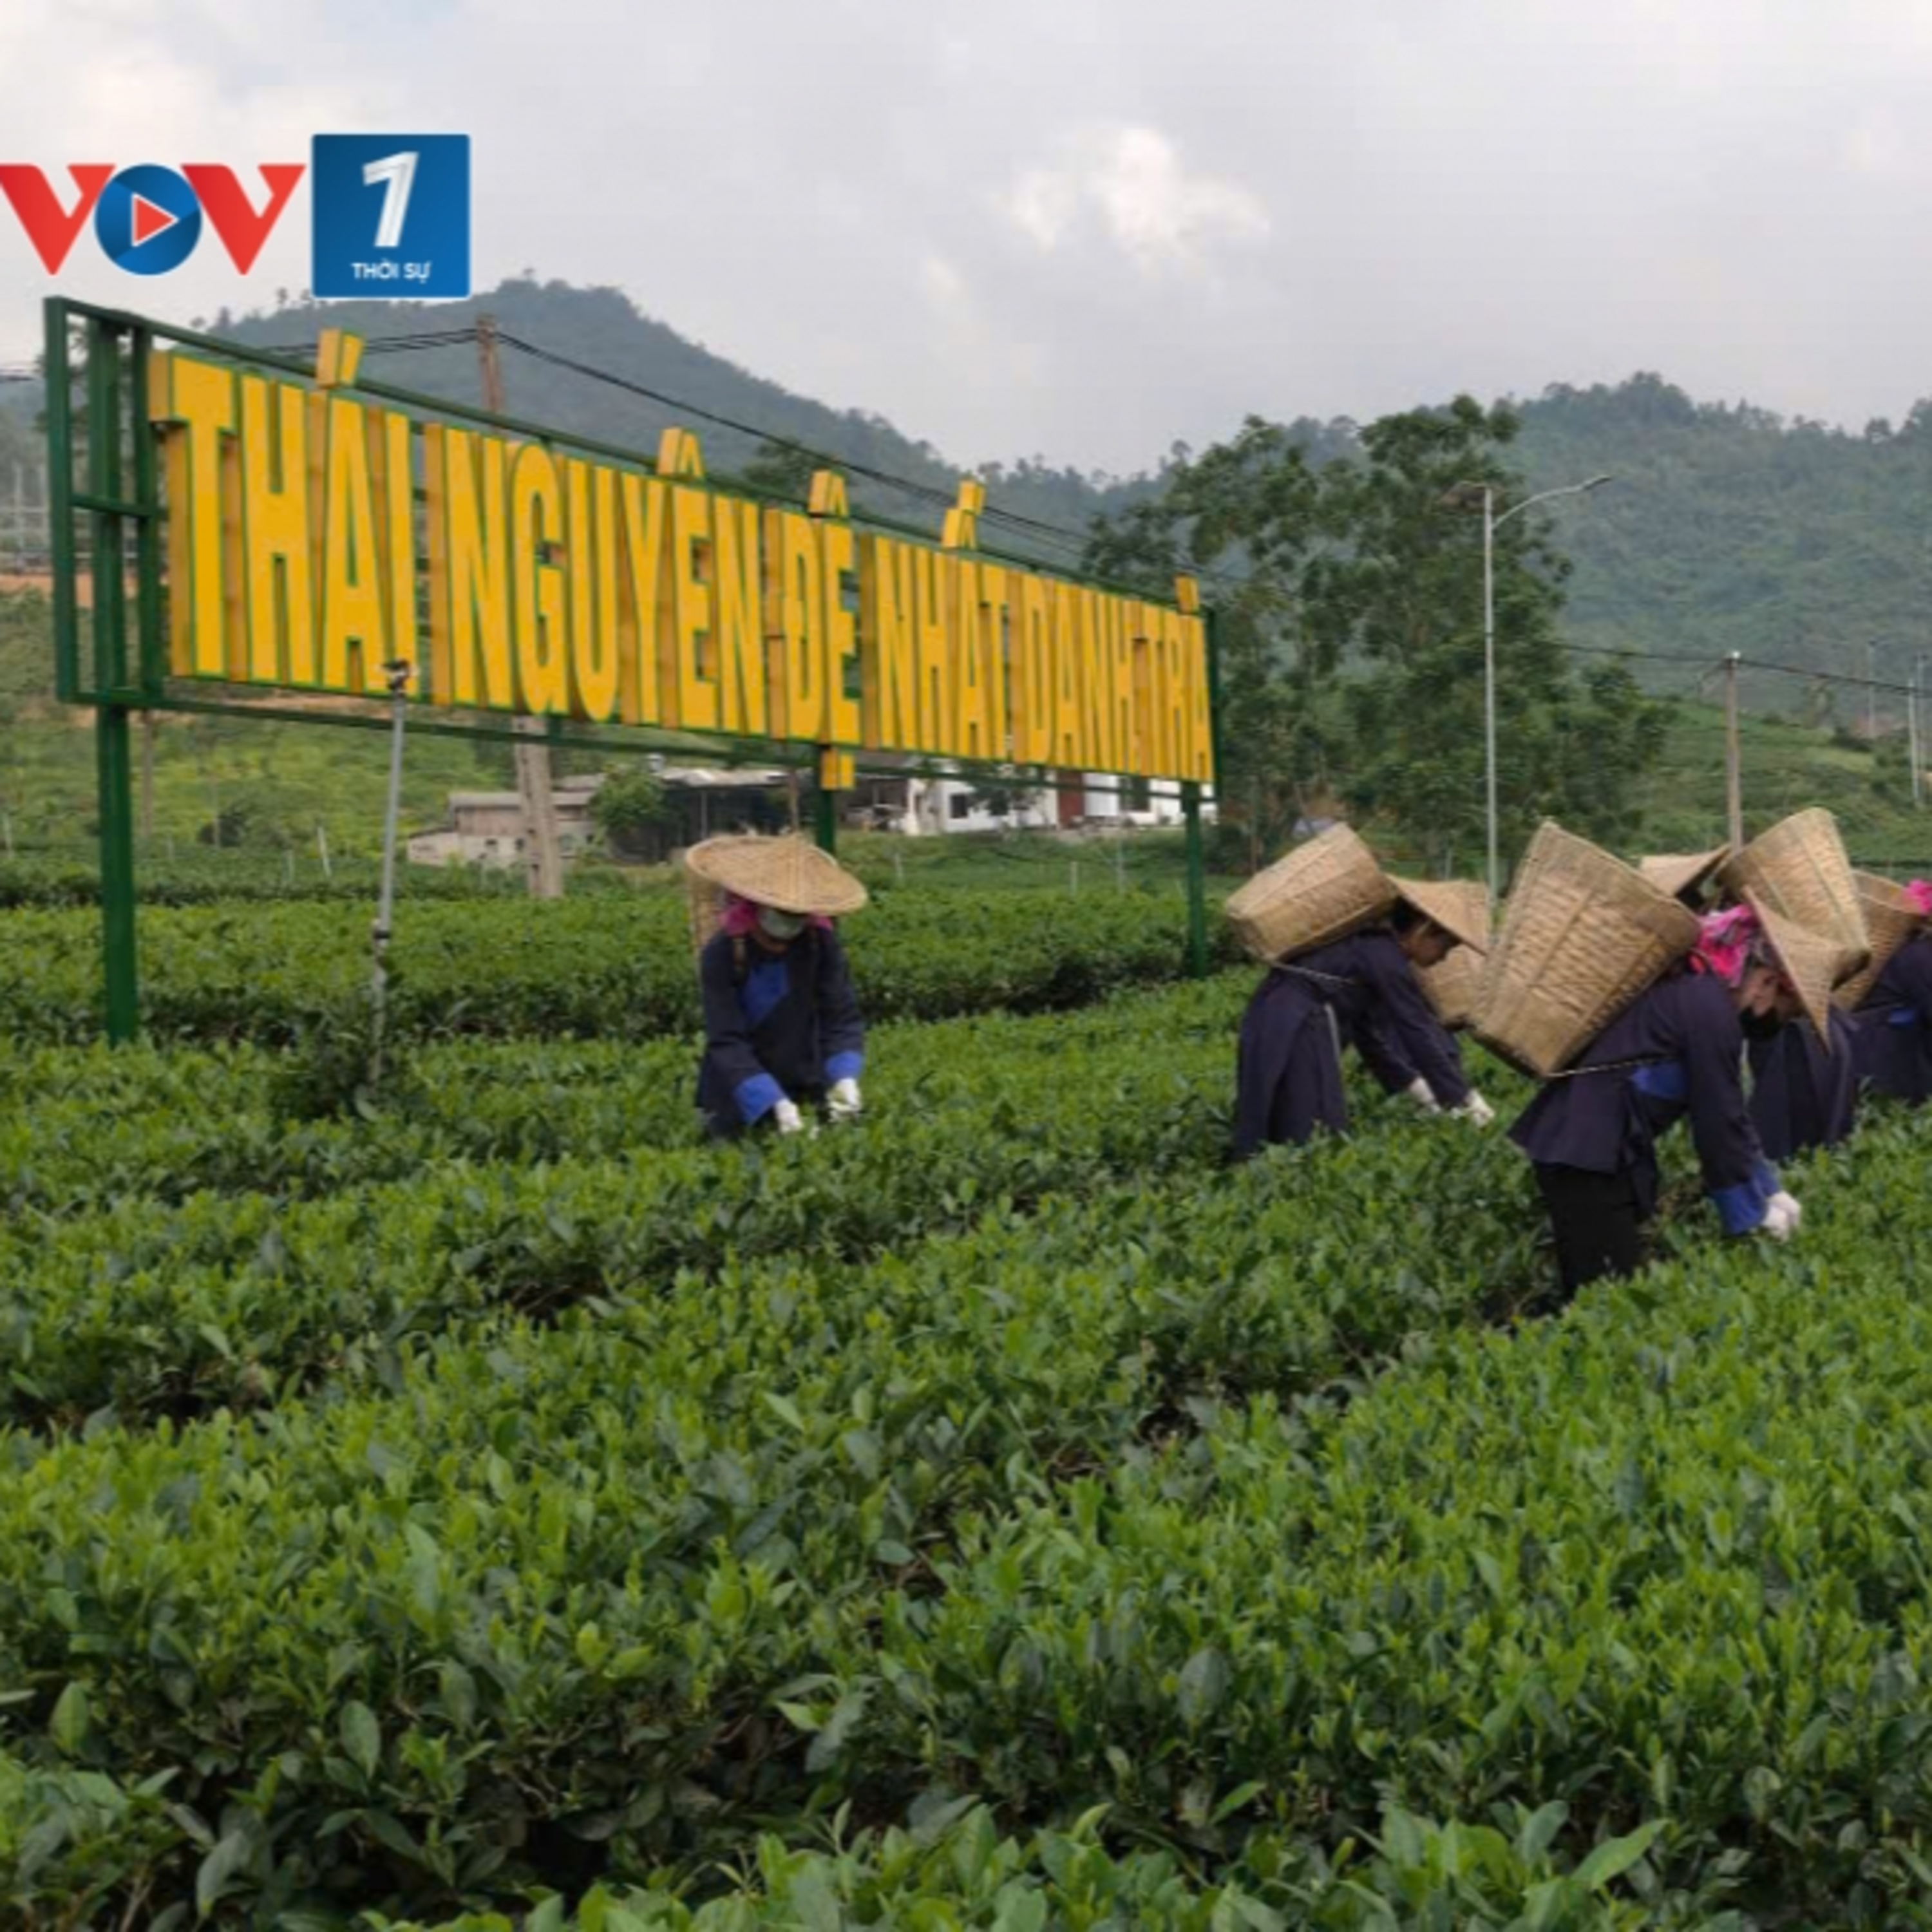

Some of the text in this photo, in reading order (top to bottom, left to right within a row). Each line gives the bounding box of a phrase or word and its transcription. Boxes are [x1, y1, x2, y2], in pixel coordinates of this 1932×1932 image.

[155, 328, 1213, 790] THÁI NGUYÊN ĐỆ NHẤT DANH TRÀ
